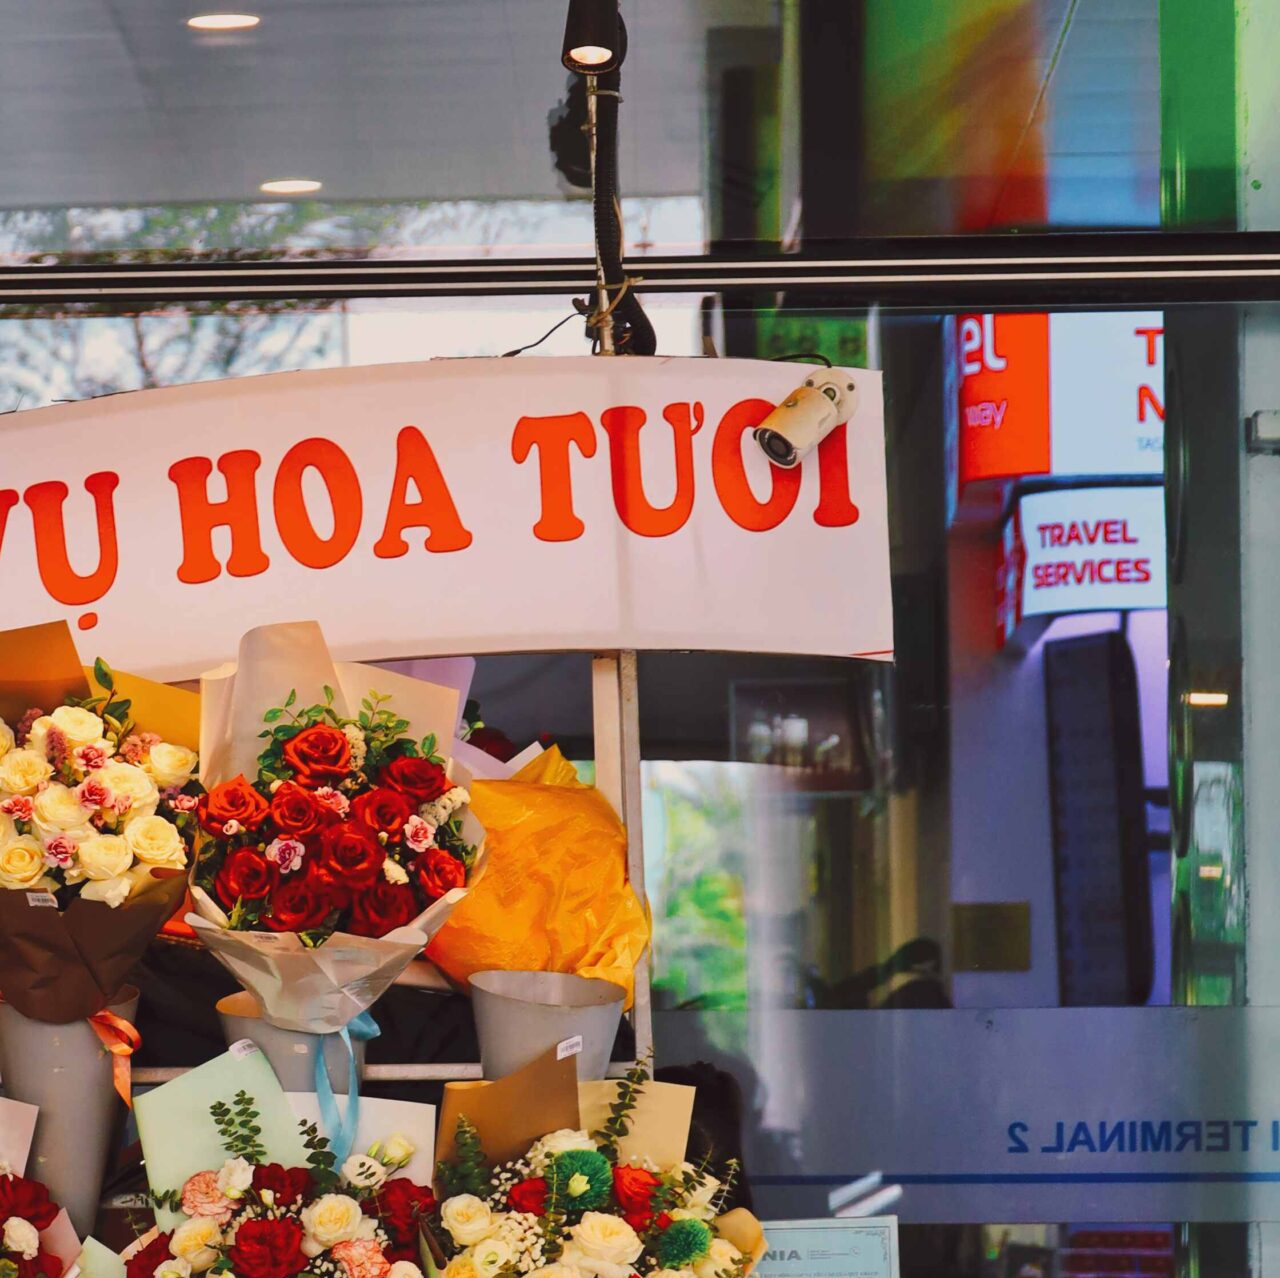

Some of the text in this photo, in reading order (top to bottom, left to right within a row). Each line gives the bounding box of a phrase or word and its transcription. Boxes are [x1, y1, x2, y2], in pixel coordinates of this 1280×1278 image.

[168, 425, 473, 584] HOA
[1037, 519, 1138, 548] TRAVEL
[1032, 558, 1151, 589] SERVICES
